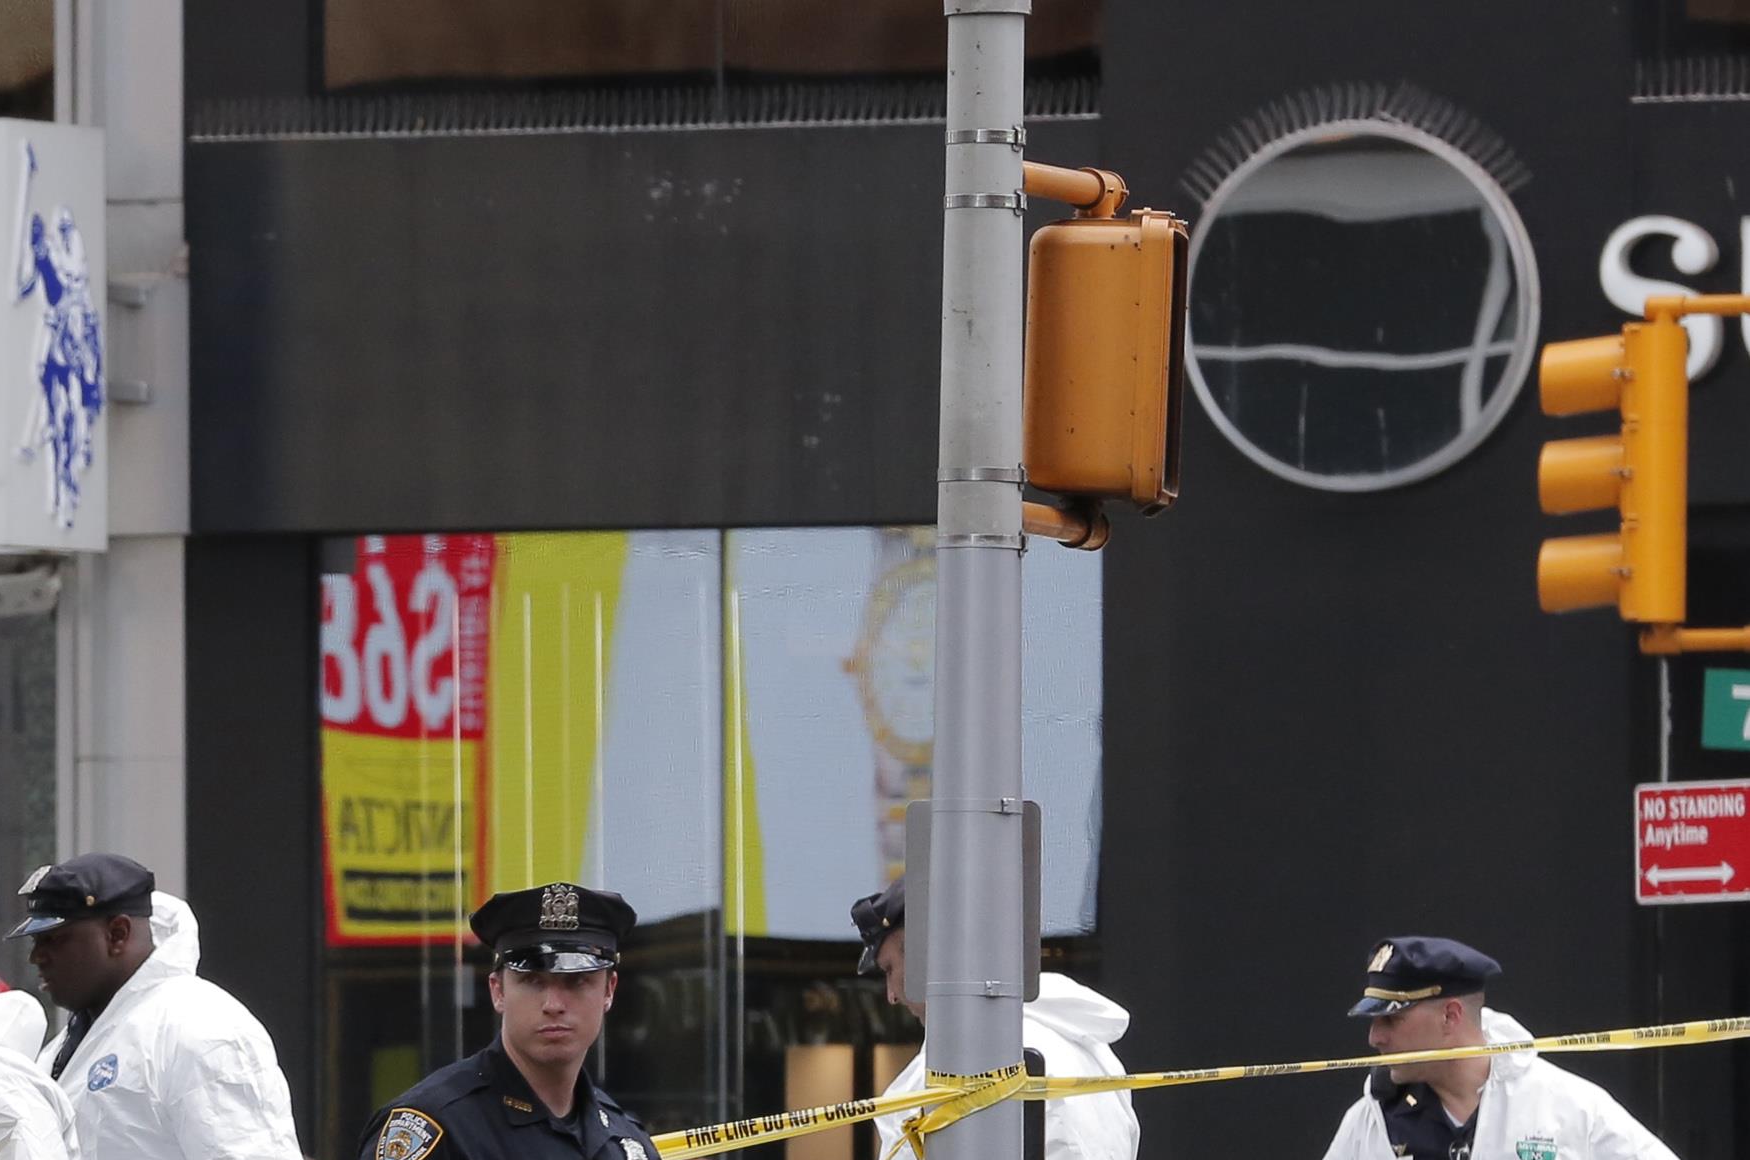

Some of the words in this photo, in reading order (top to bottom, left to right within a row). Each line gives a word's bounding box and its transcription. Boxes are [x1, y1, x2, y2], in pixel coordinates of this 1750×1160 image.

[1600, 214, 1750, 382] S
[1643, 797, 1666, 821] NO
[1669, 794, 1746, 820] STANDING
[1644, 822, 1709, 850] Anytime
[685, 1125, 721, 1148] FIRE
[724, 1119, 759, 1141] LINE
[763, 1114, 784, 1133] DO
[789, 1108, 818, 1128] NOT
